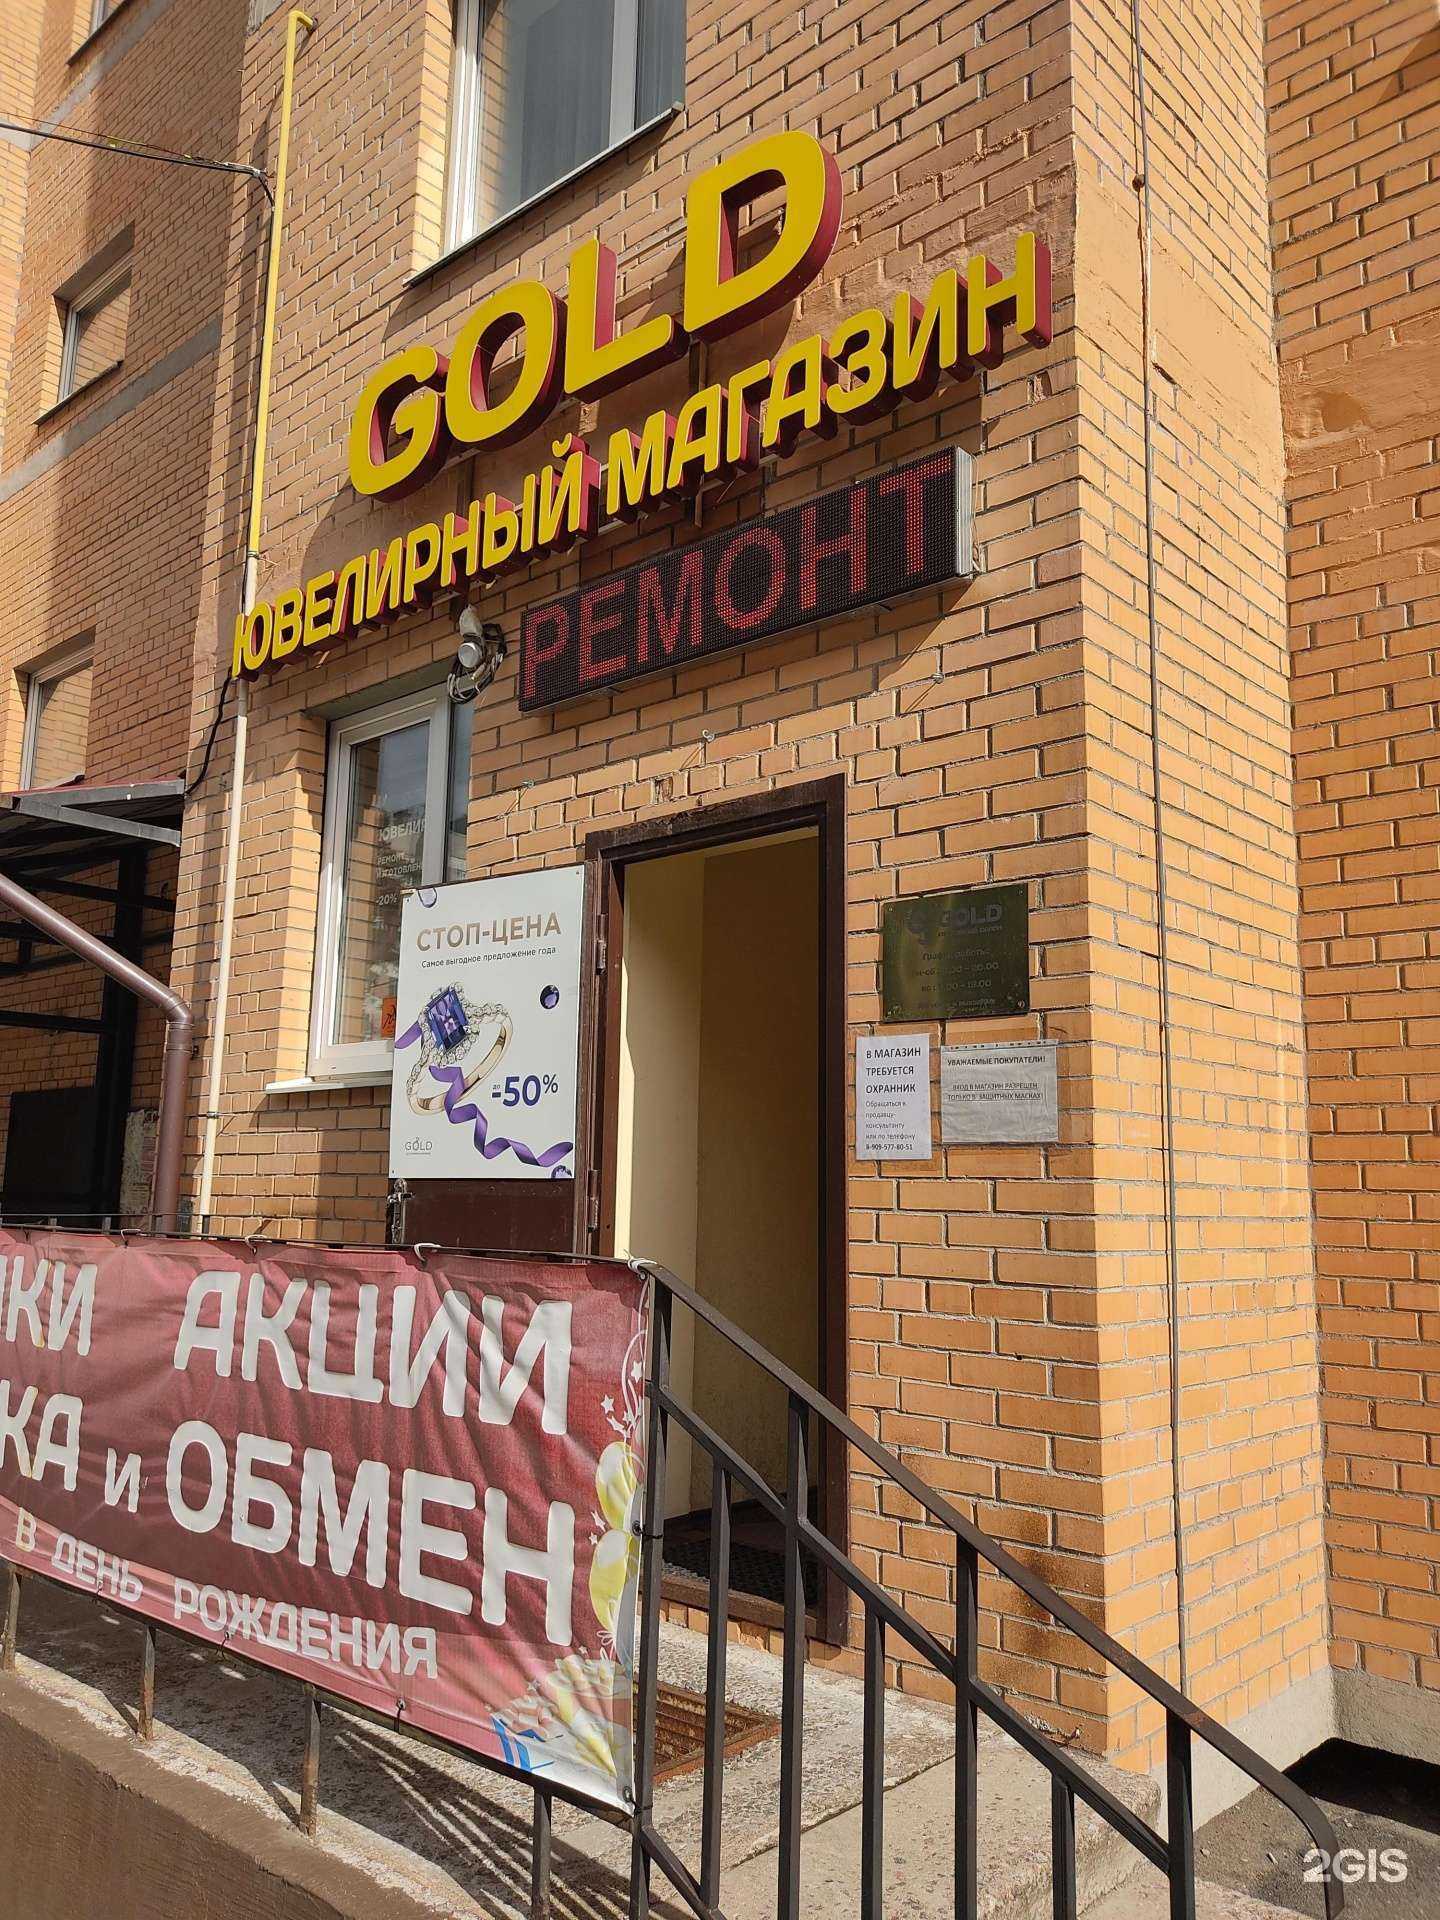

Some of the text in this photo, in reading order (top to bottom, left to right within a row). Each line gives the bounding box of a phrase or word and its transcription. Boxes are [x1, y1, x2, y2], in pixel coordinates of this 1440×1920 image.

[349, 130, 836, 498] GOLD
[232, 232, 1048, 680] ЮВЕЛИРНЫЙ МАГАЗИН
[524, 457, 955, 701] РЕМОНТ
[416, 912, 561, 951] СТОП-ЦЕНА
[421, 946, 556, 968] Самое выгодное предложение года
[866, 1047, 921, 1059] В МАГАЗИН
[947, 1055, 1046, 1066] УВАЖАЕМЫЕ ПОКУПАТЕЛИ!
[866, 1065, 914, 1076] ТРЕБУЕТСЯ
[974, 1082, 1004, 1090] МАГАЗИН
[492, 1074, 558, 1106] -50%
[866, 1083, 916, 1093] ОХРАННИК
[405, 1139, 432, 1151] GOLD
[0, 1255, 574, 1435] КИ АКЦИИ
[165, 1420, 576, 1648] ОБМЕН
[16, 1507, 438, 1680] В ДЕНЬ РОЖДЕНИЯ
